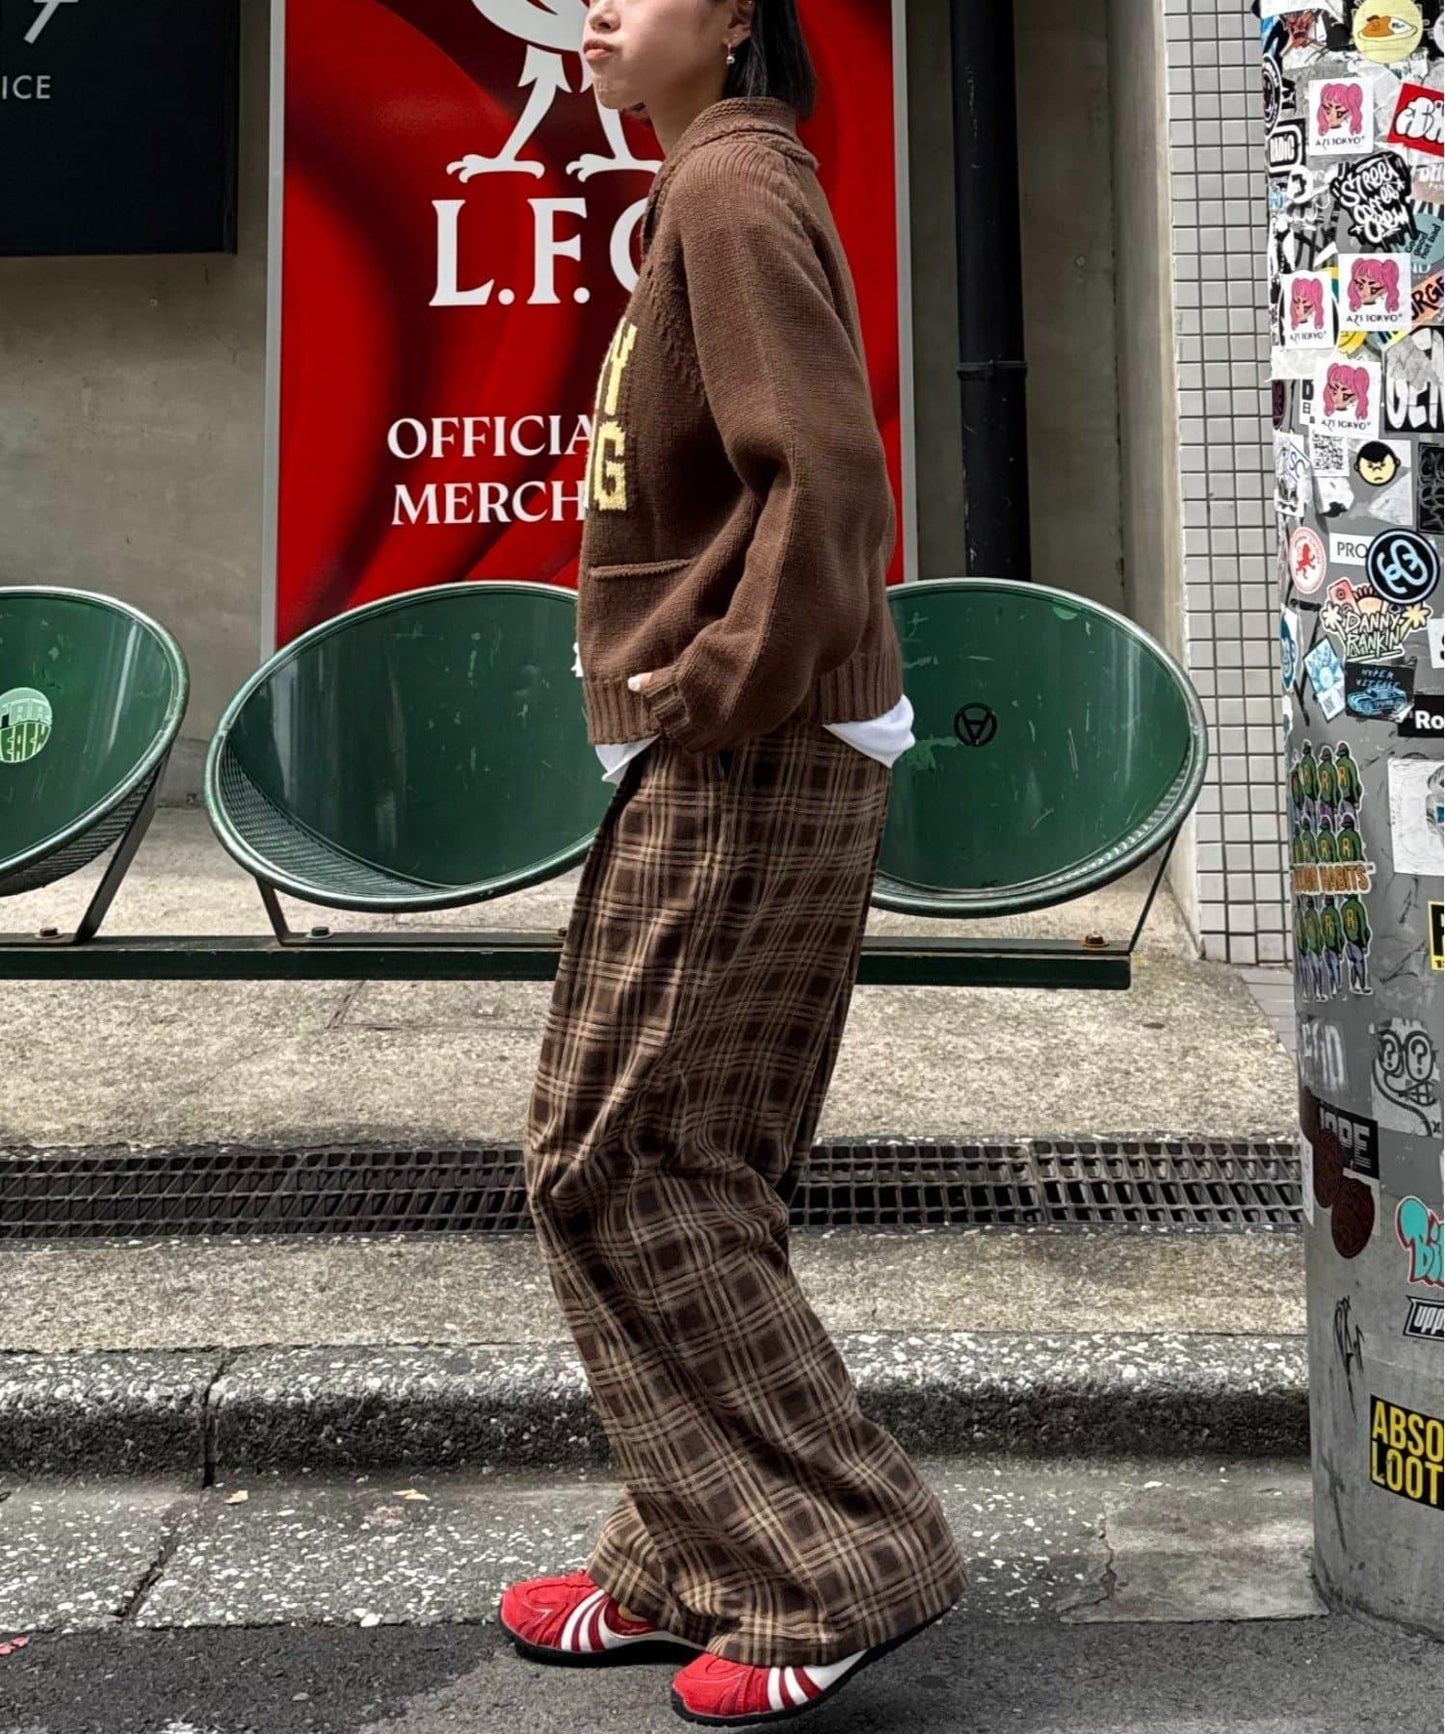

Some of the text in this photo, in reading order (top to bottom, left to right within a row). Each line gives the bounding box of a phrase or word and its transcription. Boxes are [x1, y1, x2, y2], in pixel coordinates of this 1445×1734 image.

[2, 74, 51, 100] ICE
[387, 414, 594, 460] OFFICIA
[391, 480, 588, 526] MERCH
[1346, 611, 1401, 634] DANNY
[1346, 625, 1400, 658] RANKIN
[1415, 710, 1444, 730] Ro
[1372, 1400, 1444, 1463] ABSO
[1371, 1440, 1443, 1505] LOOT
